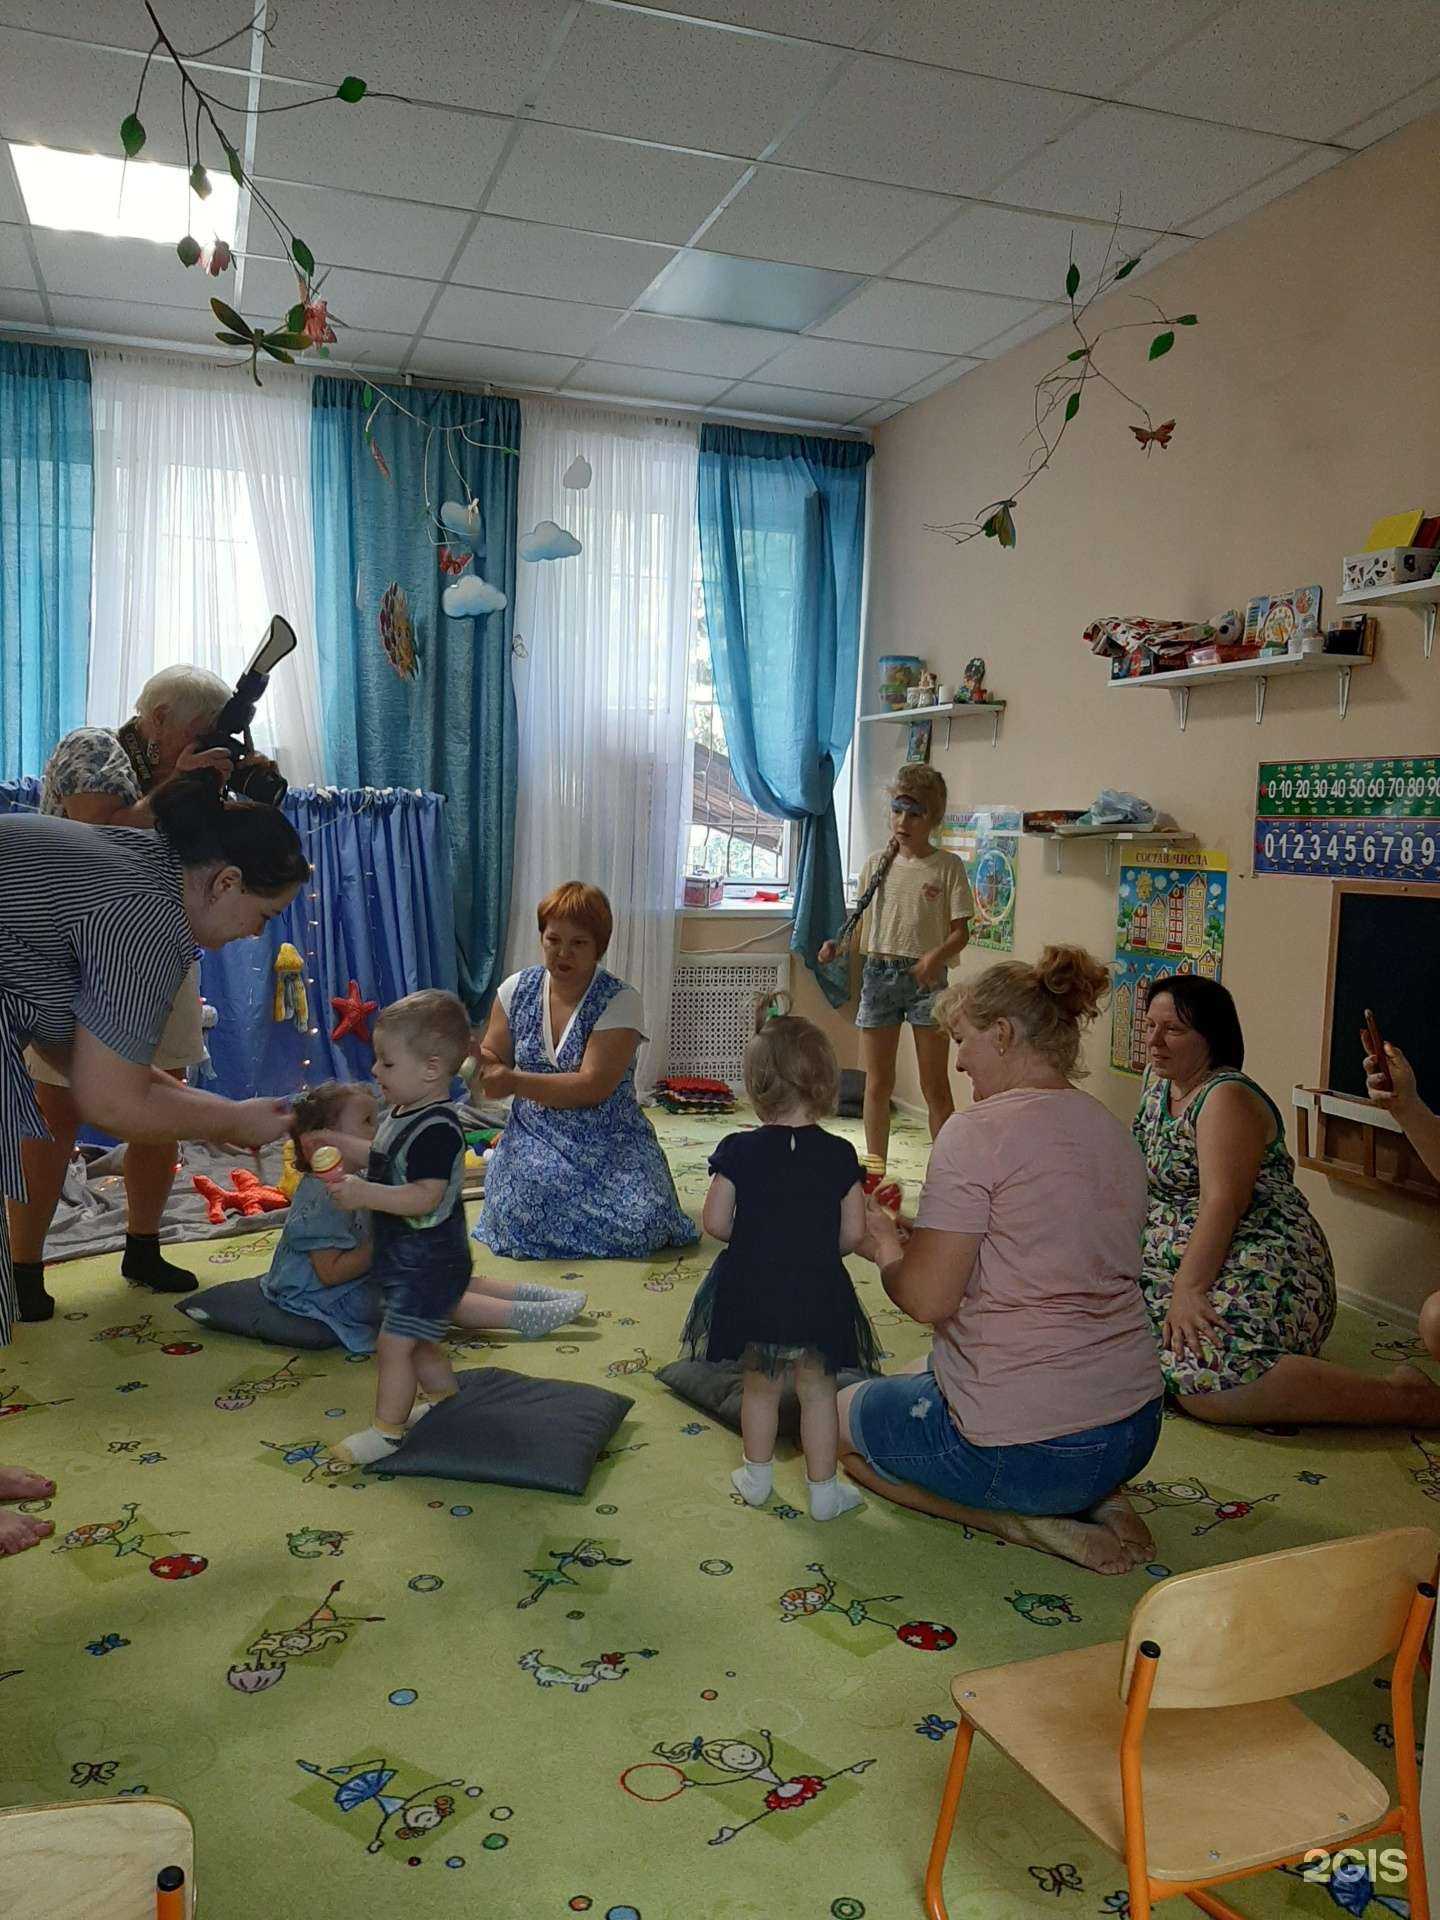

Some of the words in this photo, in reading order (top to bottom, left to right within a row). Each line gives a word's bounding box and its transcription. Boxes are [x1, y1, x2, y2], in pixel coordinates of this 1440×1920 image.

[1268, 780, 1276, 798] 0
[1279, 780, 1292, 798] 10
[1296, 780, 1310, 798] 20
[1313, 779, 1328, 798] 30
[1330, 779, 1346, 798] 40
[1350, 778, 1365, 798] 50
[1367, 778, 1384, 798] 60
[1388, 777, 1404, 798] 70
[1407, 777, 1424, 798] 80
[1136, 852, 1169, 864] СОСТАВ
[1173, 854, 1208, 866] ЧИСЛА
[1264, 833, 1274, 858] 0
[1279, 833, 1287, 859] 1
[1293, 834, 1304, 859] 2
[1310, 834, 1321, 860] 3
[1326, 835, 1338, 861] 4
[1345, 835, 1356, 862] 5
[1363, 836, 1375, 863] 6
[1381, 836, 1394, 863] 7
[1401, 836, 1413, 864] 8
[1421, 837, 1435, 865] 9
